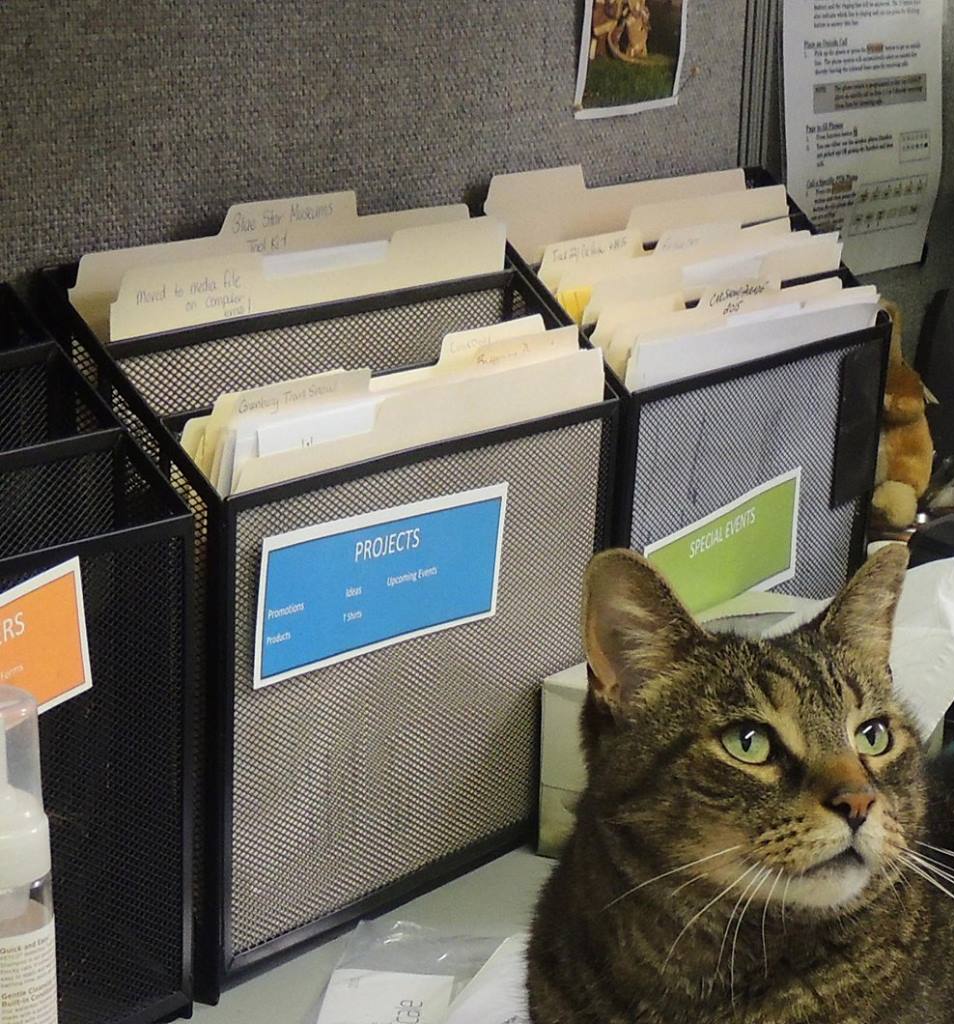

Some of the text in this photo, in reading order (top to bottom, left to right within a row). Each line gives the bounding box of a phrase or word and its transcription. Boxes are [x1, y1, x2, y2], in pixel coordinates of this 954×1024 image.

[689, 507, 756, 559] SPECIAL EVENTS
[355, 528, 420, 562] PROJECTS
[387, 566, 438, 587] Upcoming Events
[346, 586, 362, 598] Ideas
[267, 602, 305, 620] Promotions
[346, 611, 362, 622] Shirts
[266, 632, 291, 645] Products
